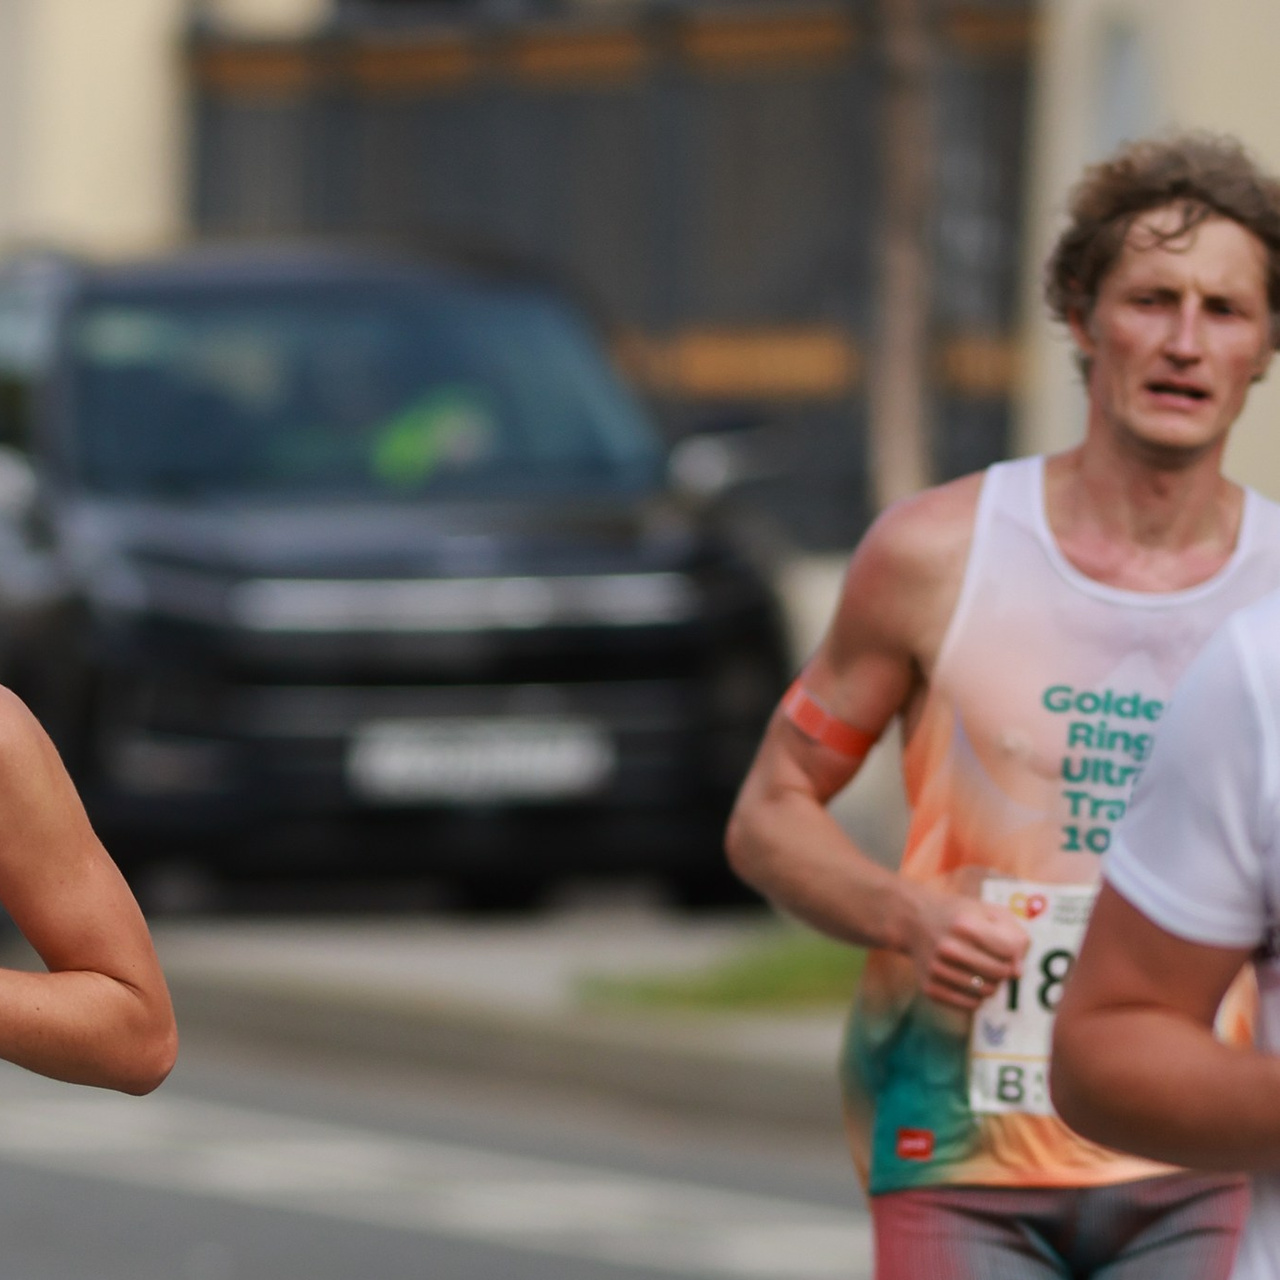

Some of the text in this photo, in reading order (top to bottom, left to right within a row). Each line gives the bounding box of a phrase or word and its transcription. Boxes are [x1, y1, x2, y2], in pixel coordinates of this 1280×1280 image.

[1041, 684, 1165, 722] Golde
[1061, 756, 1144, 787] Ultr
[1061, 790, 1128, 822] Tra
